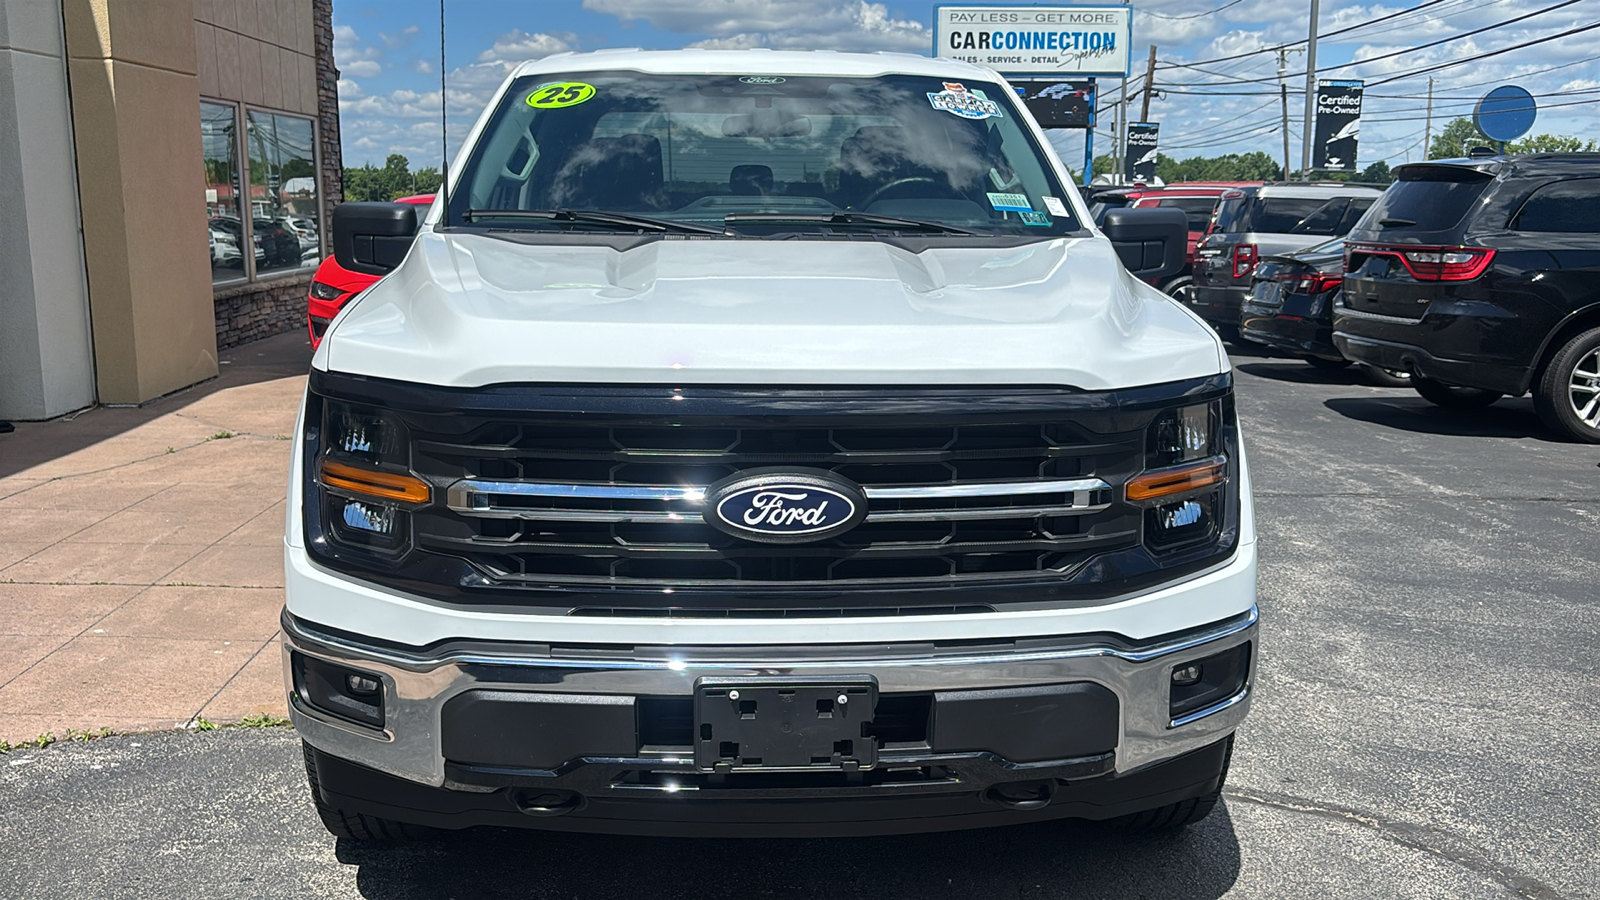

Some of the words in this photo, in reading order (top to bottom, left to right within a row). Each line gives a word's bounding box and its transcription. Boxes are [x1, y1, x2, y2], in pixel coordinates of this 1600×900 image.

[950, 13, 977, 22] PAY
[981, 13, 1018, 22] LESS
[1035, 13, 1065, 23] GET
[1069, 14, 1119, 23] MORE.
[747, 76, 778, 84] Ford
[536, 86, 587, 104] 25
[1318, 94, 1361, 105] Certified
[1317, 106, 1360, 114] Pre-Owned
[1128, 131, 1158, 140] Certified
[743, 491, 829, 526] Ford
